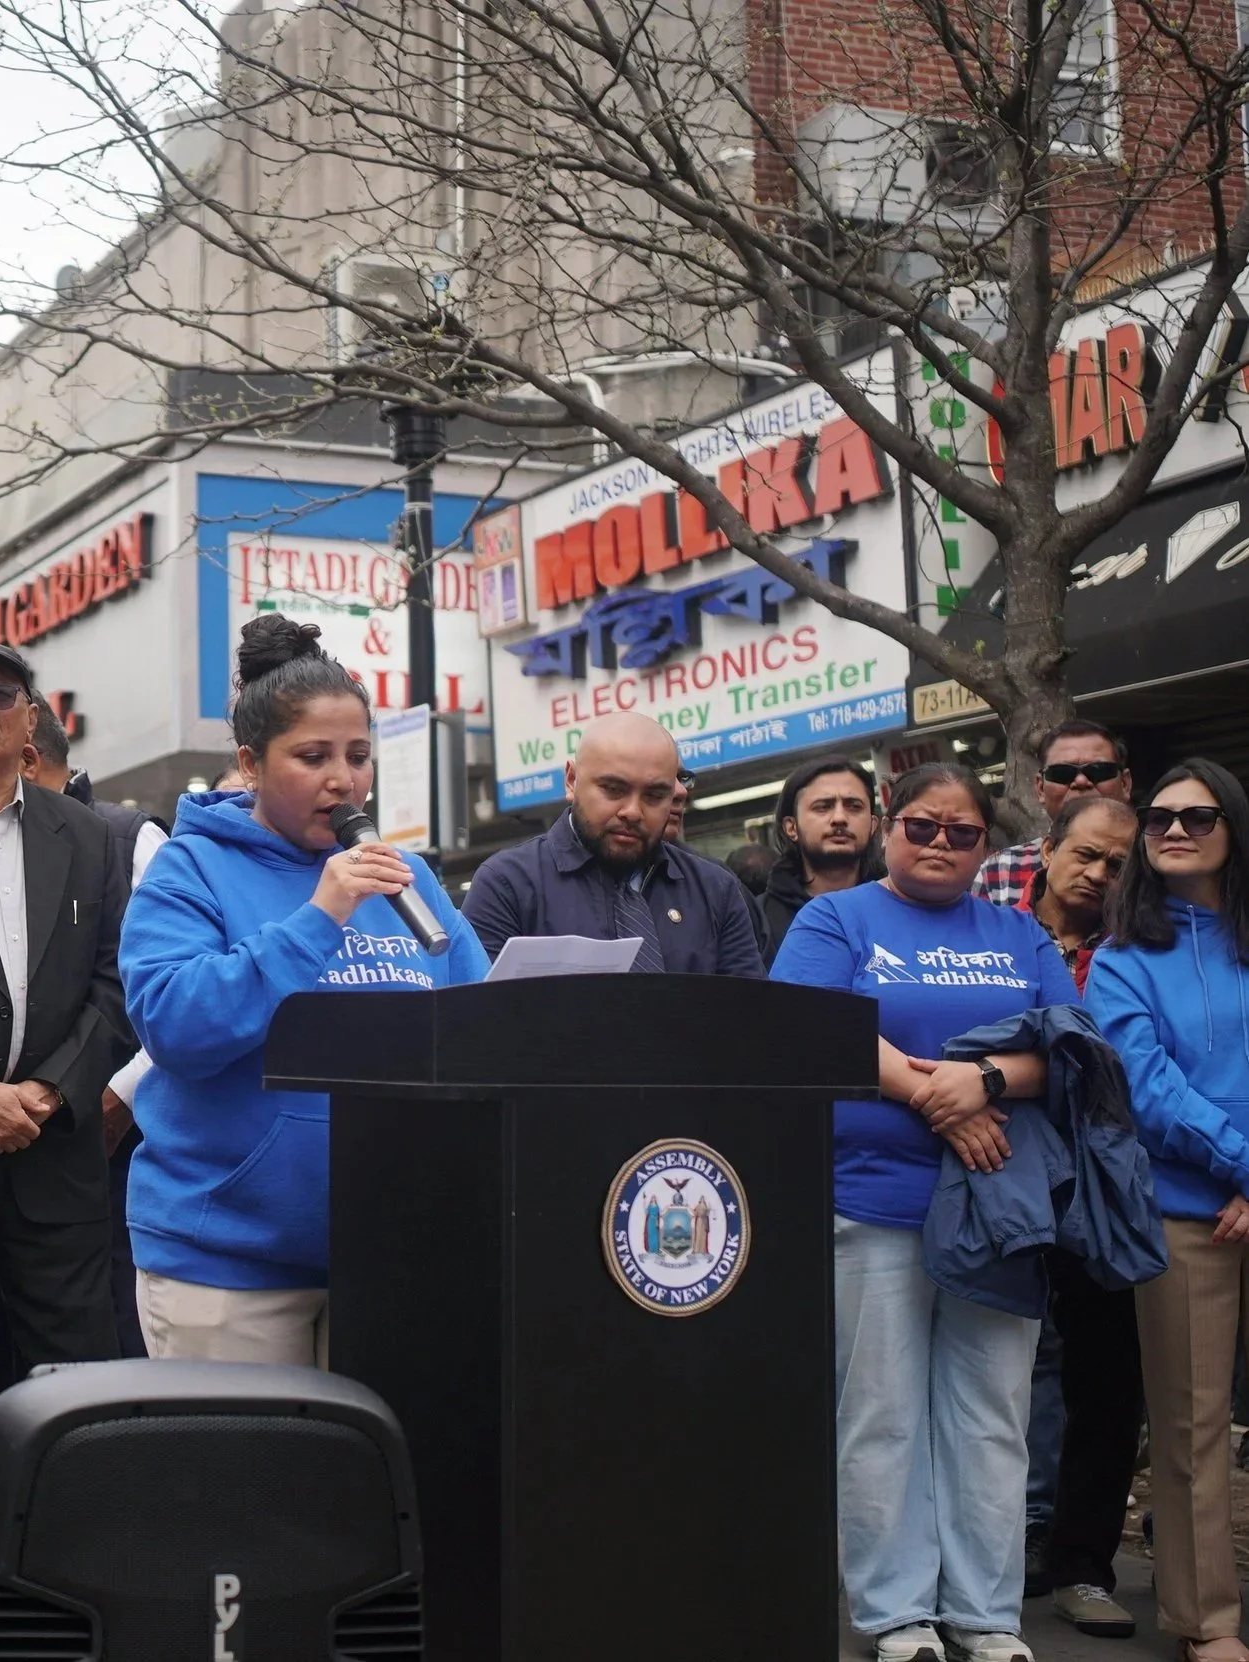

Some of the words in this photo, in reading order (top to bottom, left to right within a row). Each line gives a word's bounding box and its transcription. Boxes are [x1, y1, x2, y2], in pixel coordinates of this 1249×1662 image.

[569, 462, 648, 516] JACKSON
[535, 414, 882, 611] MOLLIKA
[5, 511, 144, 648] GARDEN
[364, 617, 391, 655] &
[551, 624, 820, 728] ELECTRONICS
[518, 738, 555, 765] We
[565, 727, 582, 755] D
[658, 702, 711, 731] ney
[727, 657, 879, 718] Transfer
[807, 711, 830, 733] Tel:
[327, 961, 434, 990] adhikaar
[916, 946, 1018, 975] अधिकार
[922, 971, 1029, 990] adhikaar
[635, 1151, 727, 1188] ASSEMBLY
[615, 1229, 646, 1287] STATE
[644, 1280, 669, 1302] OF
[670, 1266, 710, 1304] NEW
[708, 1232, 740, 1285] YORK
